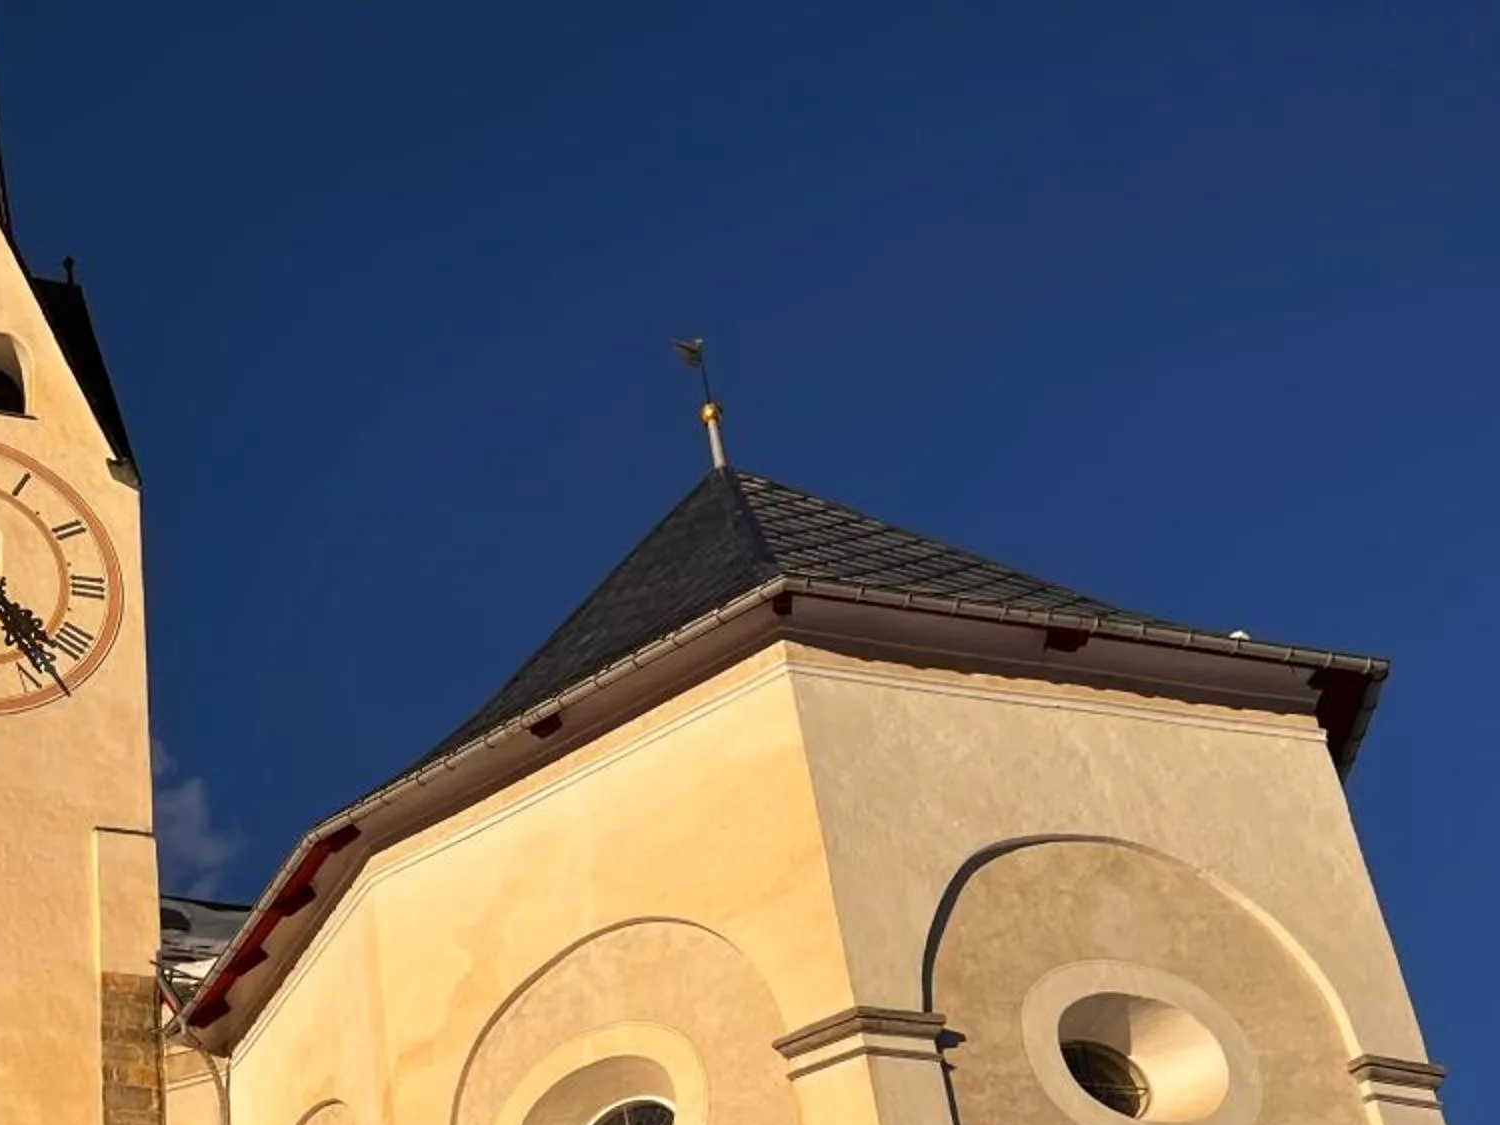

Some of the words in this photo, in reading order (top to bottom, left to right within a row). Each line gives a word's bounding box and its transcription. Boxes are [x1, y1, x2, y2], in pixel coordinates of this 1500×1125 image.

[12, 472, 31, 496] I
[51, 519, 86, 540] II
[70, 575, 105, 600] III
[15, 661, 43, 693] V
